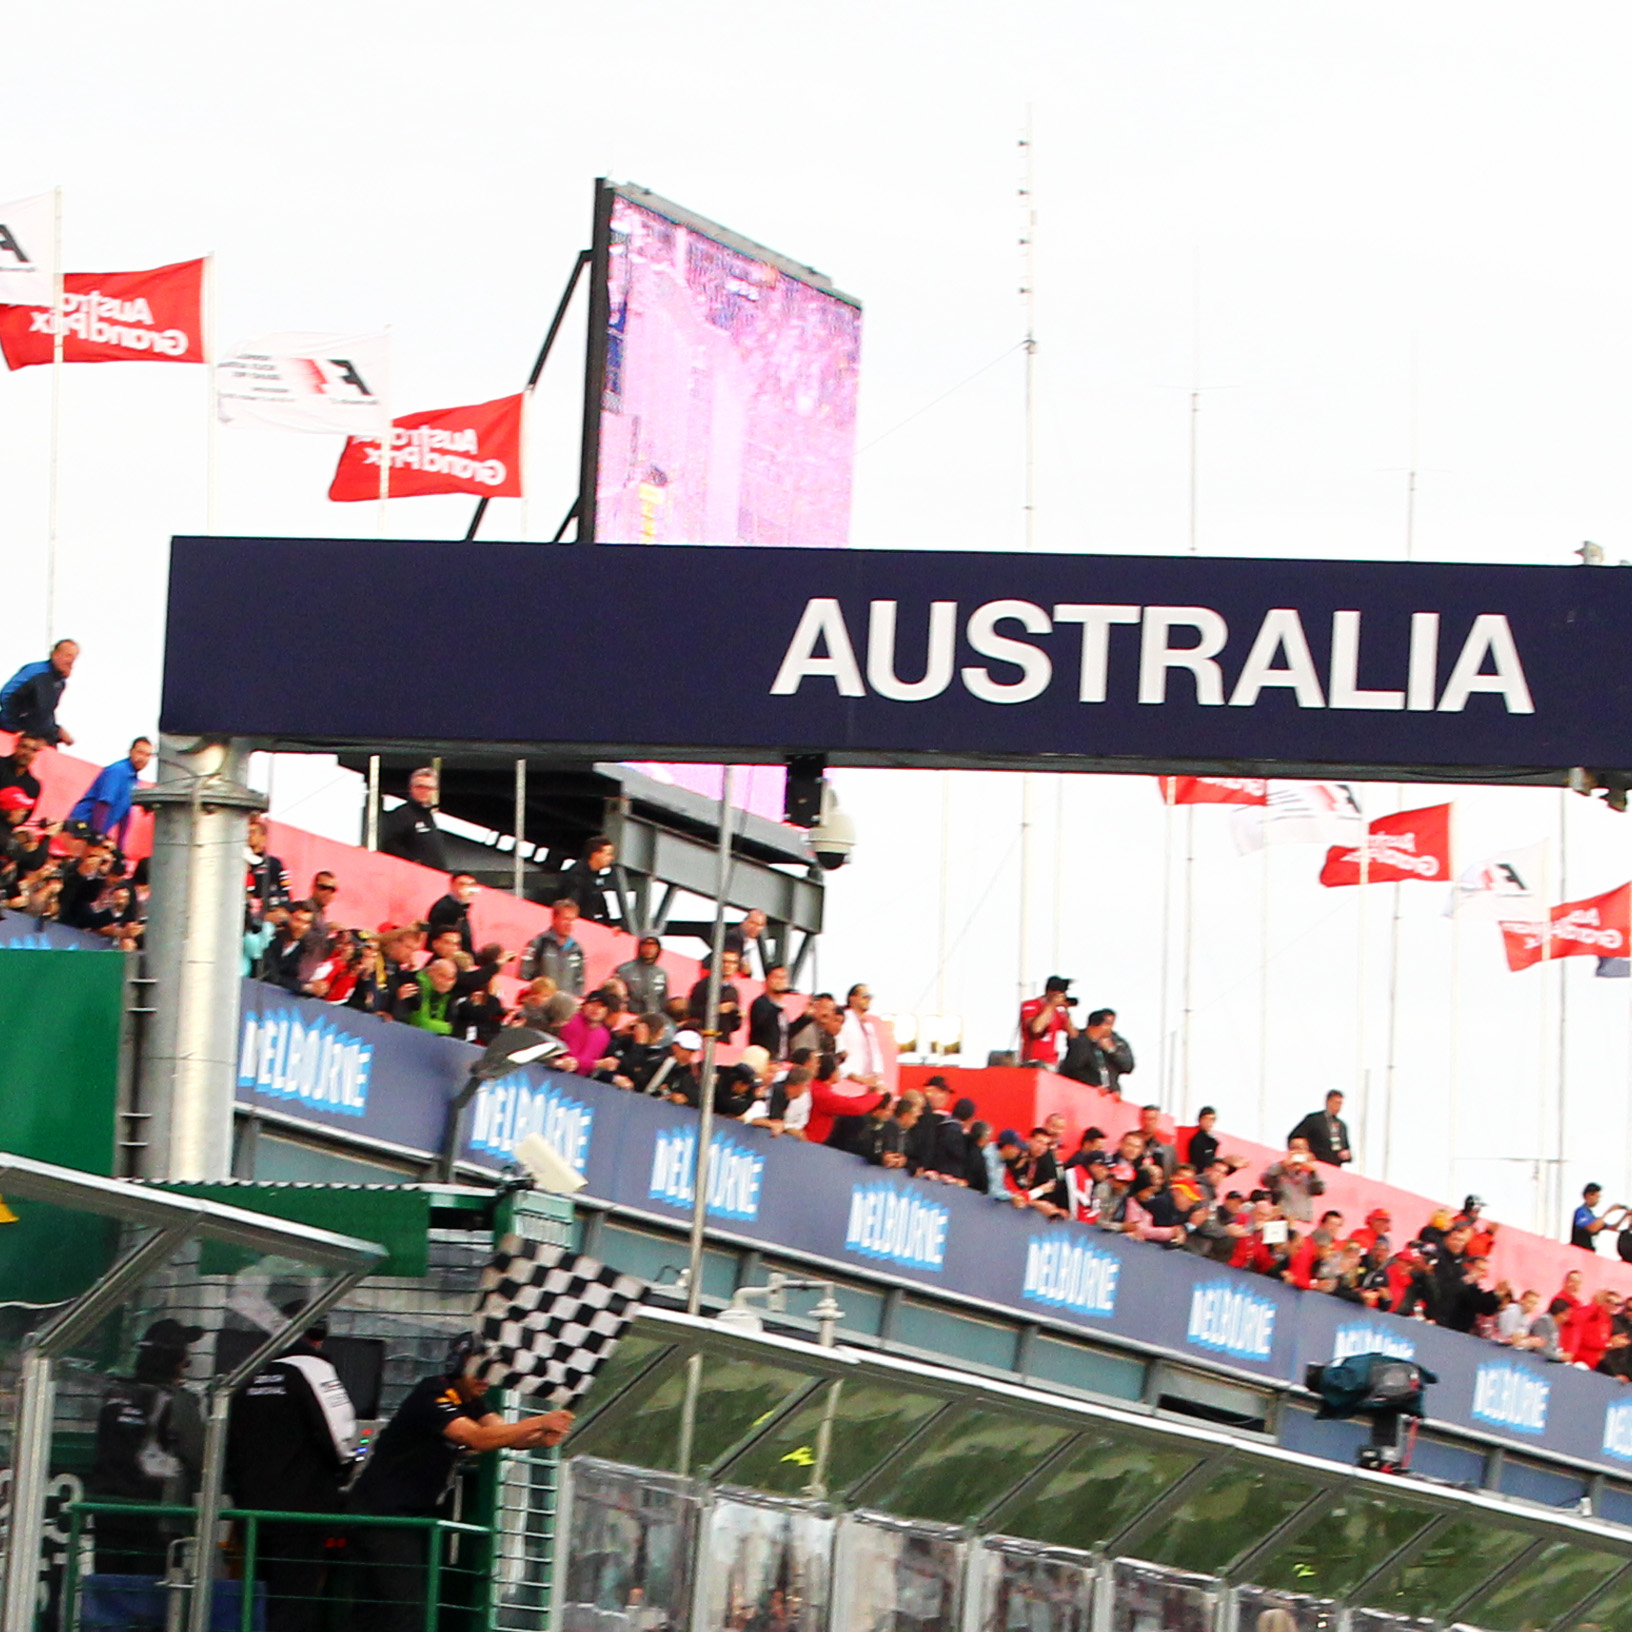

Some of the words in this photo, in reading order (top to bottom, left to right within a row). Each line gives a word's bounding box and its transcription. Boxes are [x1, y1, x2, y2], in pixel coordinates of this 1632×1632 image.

[769, 597, 1536, 715] AUSTRALIA
[237, 1018, 371, 1110] MELBOURNE
[649, 1136, 764, 1216] MELOURNE
